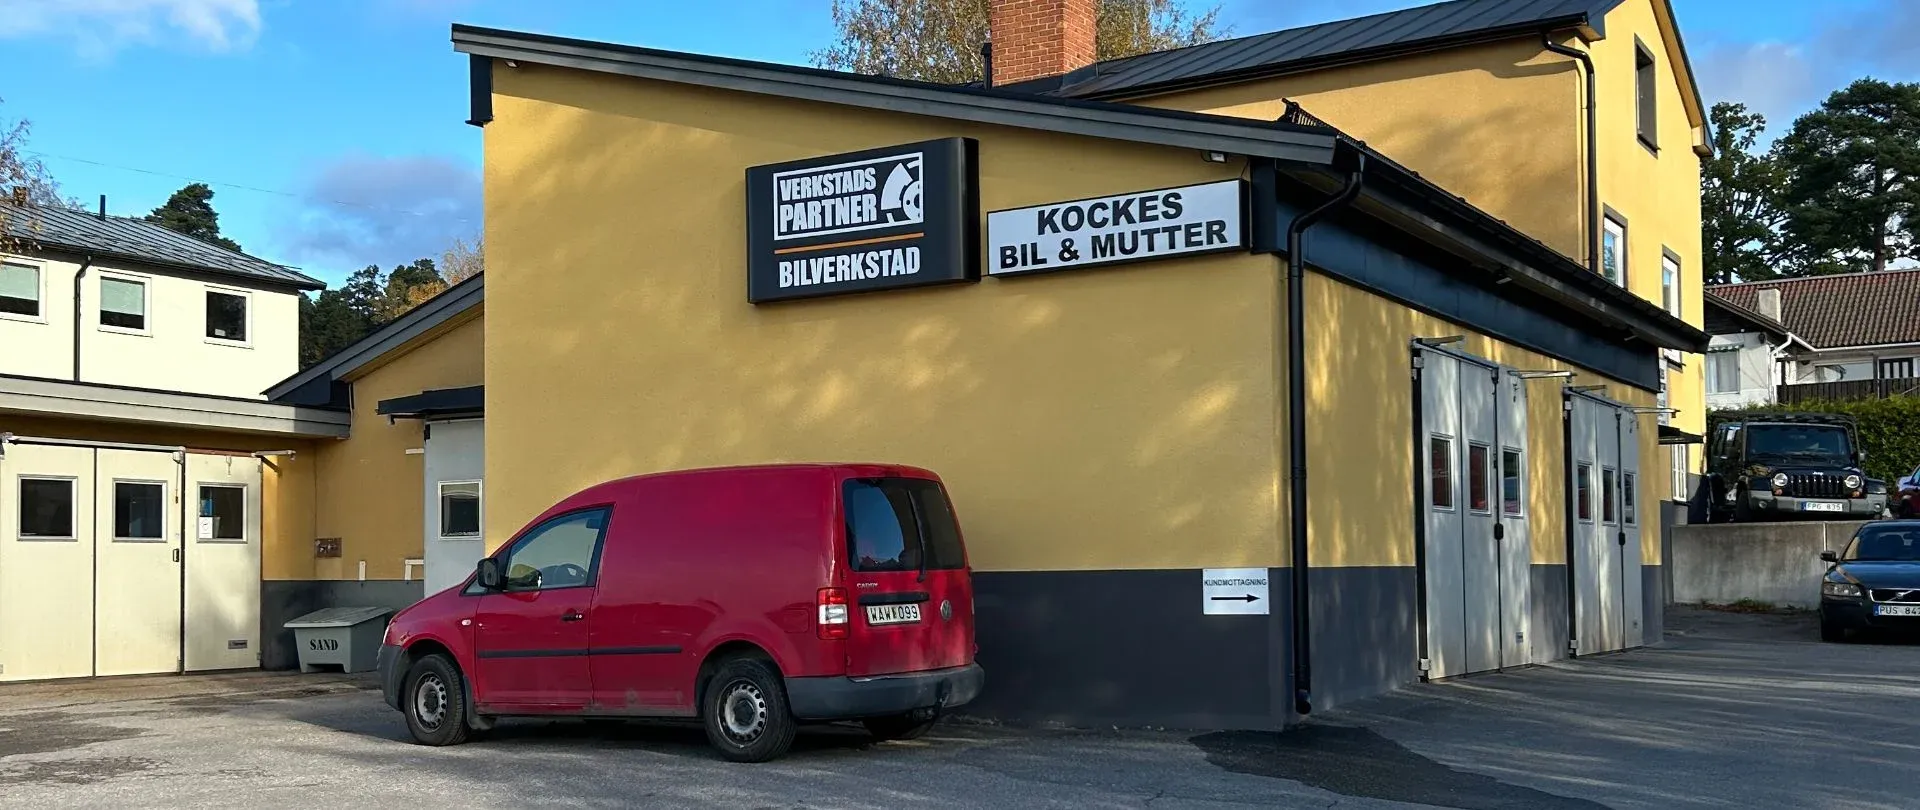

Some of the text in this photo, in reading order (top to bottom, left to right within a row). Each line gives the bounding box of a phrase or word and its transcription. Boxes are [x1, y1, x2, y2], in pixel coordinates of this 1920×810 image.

[779, 167, 877, 202] VERKSTADS
[780, 193, 878, 233] PARTNER
[1037, 192, 1184, 236] KOCKES
[999, 219, 1229, 270] BIL & MUTTER
[778, 246, 921, 288] BILVERKSTAD
[1204, 578, 1267, 586] KUNDMOTTAGNING
[870, 605, 918, 621] WAW 099
[1879, 606, 1898, 615] PUS
[309, 639, 338, 651] SAND
